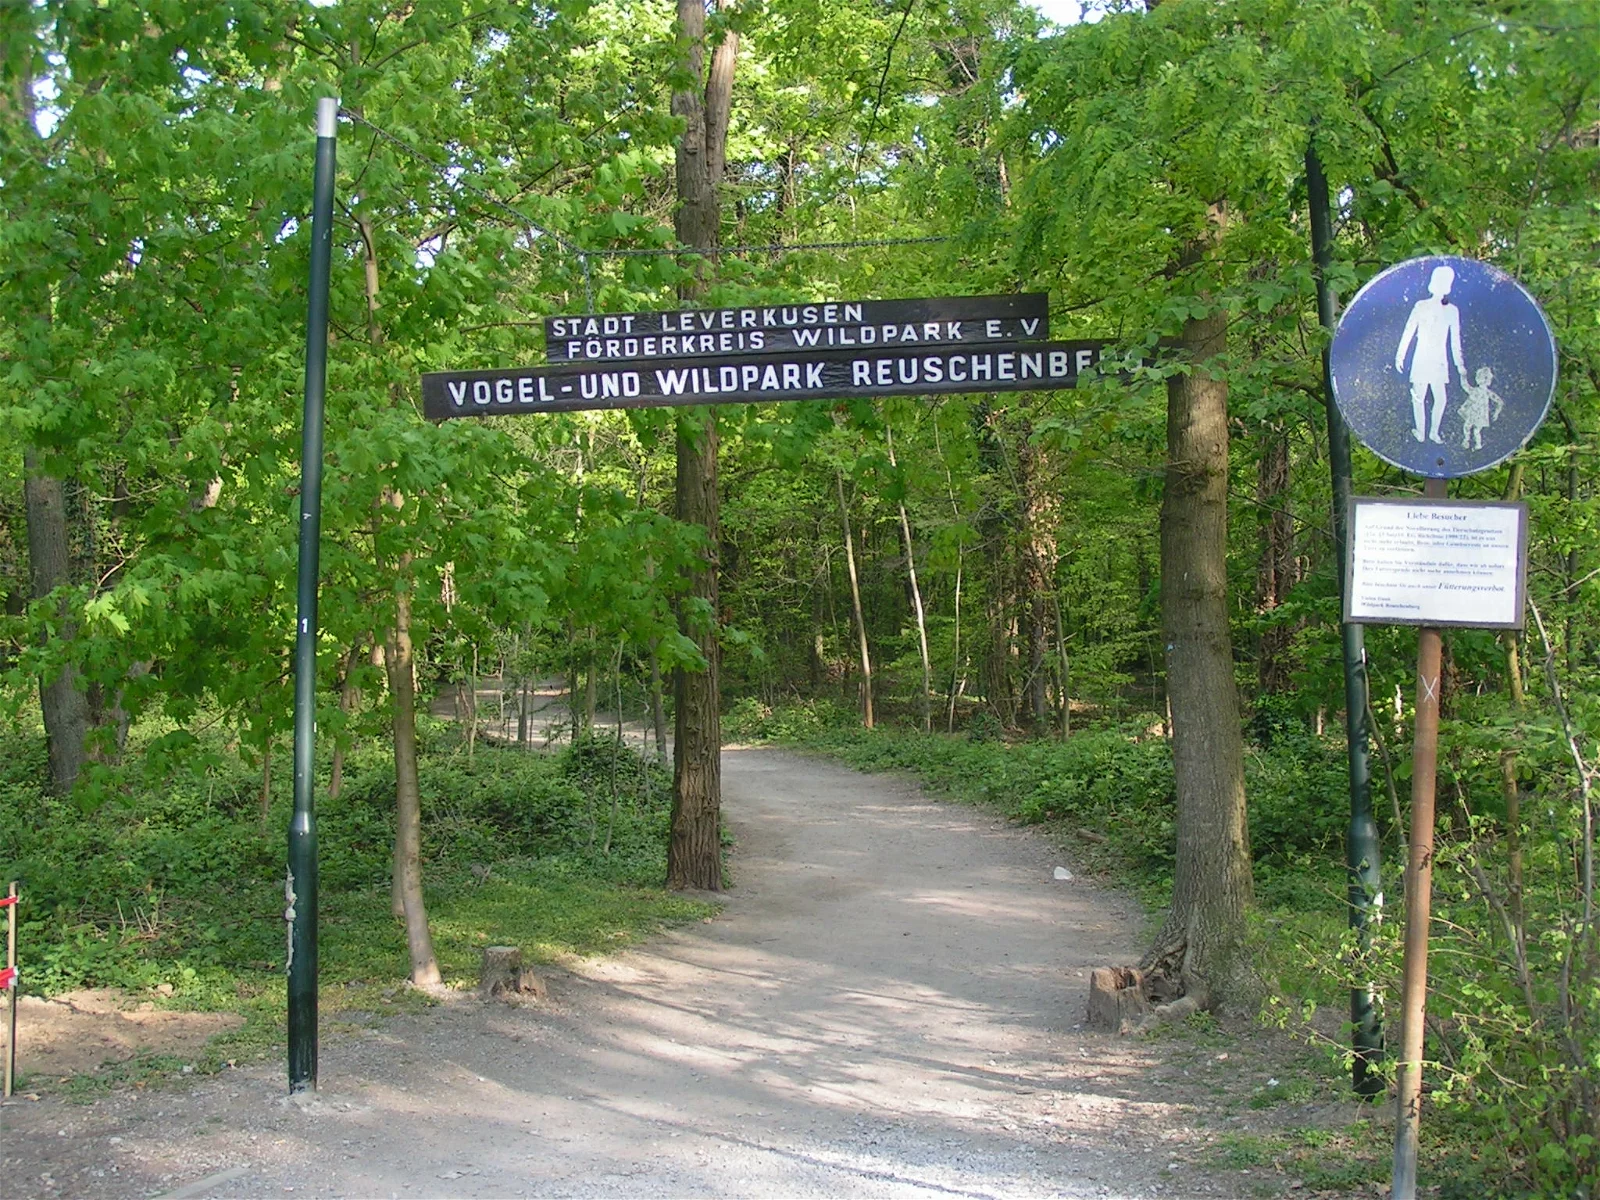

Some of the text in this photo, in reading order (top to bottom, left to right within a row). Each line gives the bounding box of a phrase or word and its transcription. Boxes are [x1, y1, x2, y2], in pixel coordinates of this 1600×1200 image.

[552, 303, 864, 338] STADT LEVERKUSEN
[567, 330, 766, 360] FÖRDERKREIS
[792, 320, 963, 347] WILDPARK
[655, 360, 826, 397] WILDPARK
[852, 348, 1144, 387] REUSCHENBE
[1407, 512, 1468, 521] Liebe Besucher
[302, 618, 308, 633] 1
